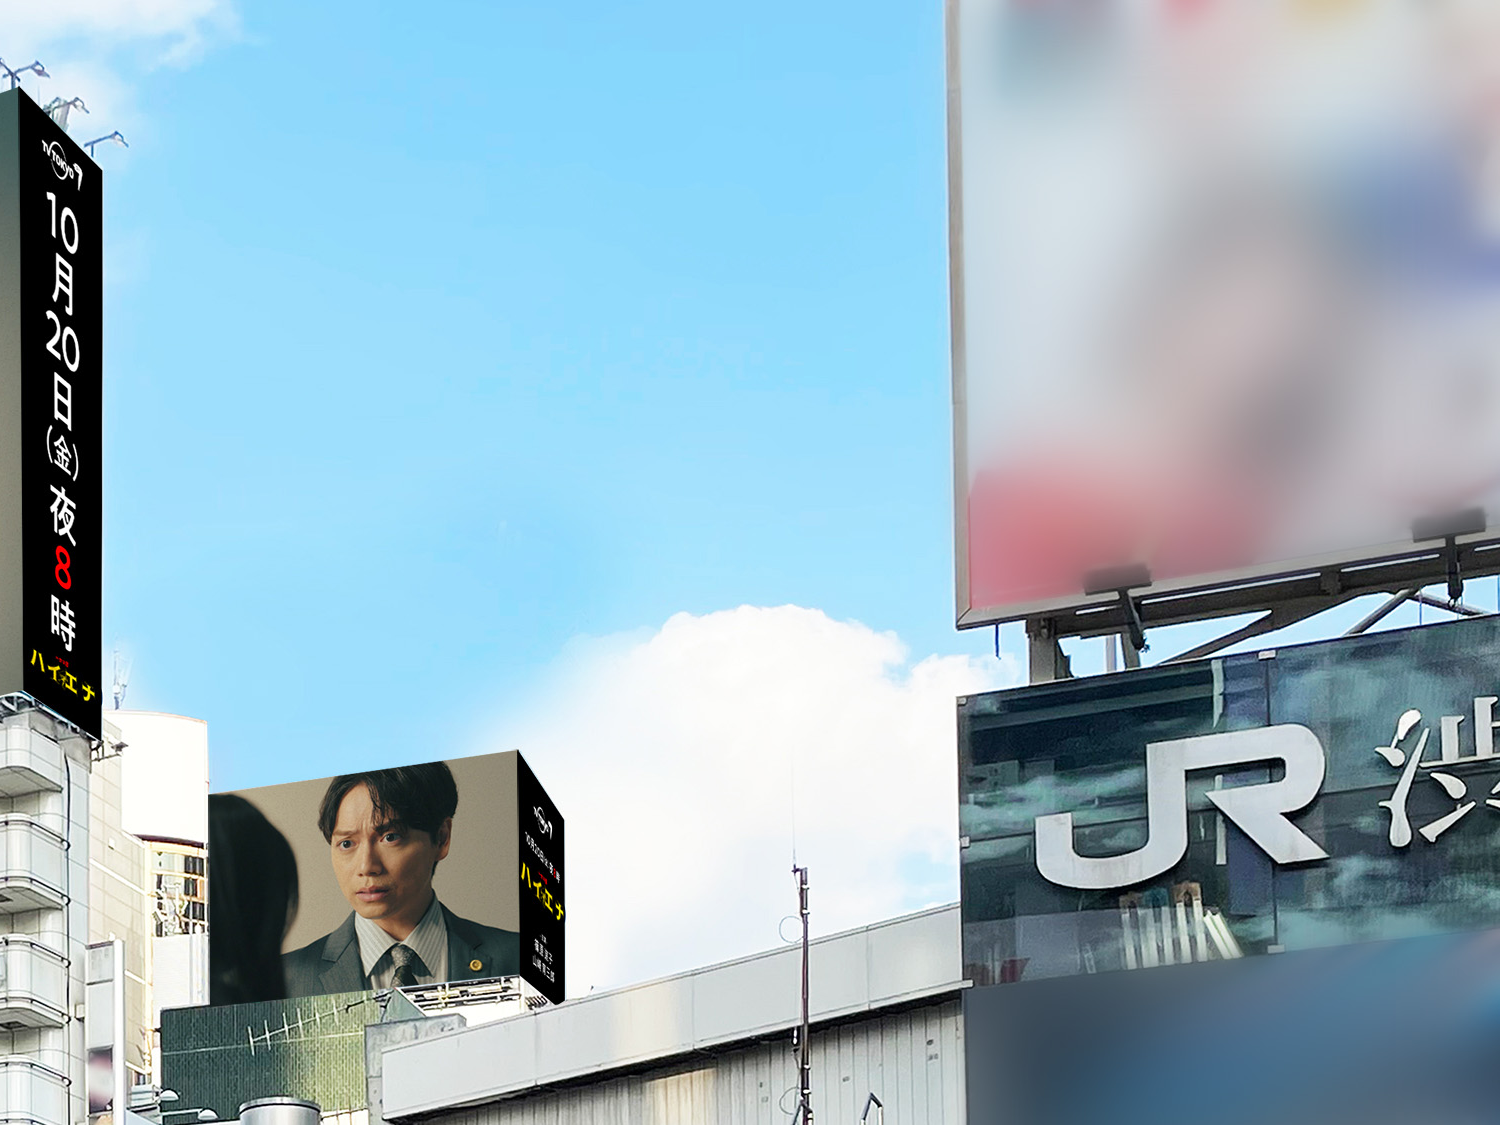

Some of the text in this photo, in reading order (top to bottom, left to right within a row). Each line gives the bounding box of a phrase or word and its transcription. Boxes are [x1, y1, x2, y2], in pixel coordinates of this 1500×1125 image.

[51, 149, 74, 180] TOKYO
[30, 649, 96, 702] ハイエナ
[1034, 723, 1330, 889] JR
[521, 862, 565, 921] ハイエナ
